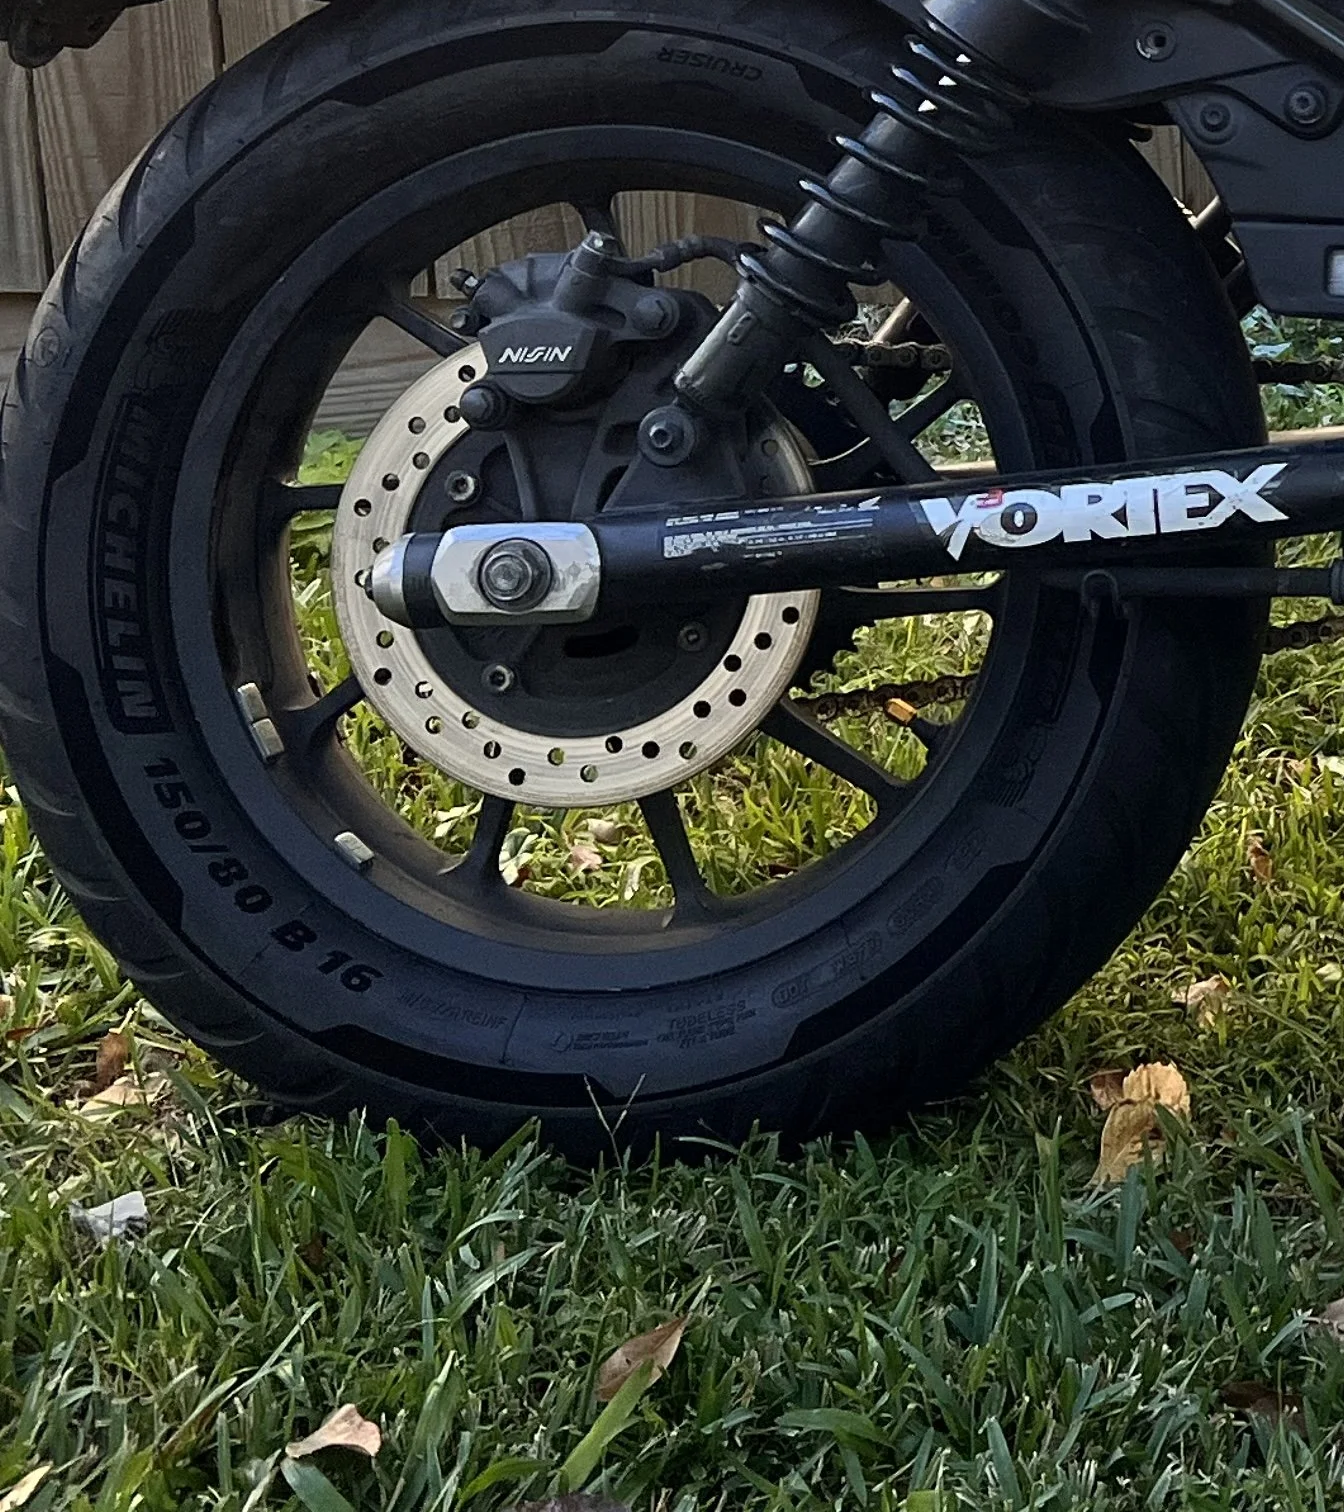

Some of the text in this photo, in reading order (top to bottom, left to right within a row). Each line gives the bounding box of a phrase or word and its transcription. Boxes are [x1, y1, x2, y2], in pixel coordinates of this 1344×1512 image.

[657, 46, 763, 80] CRUISER
[103, 399, 158, 718] MICHELIN
[920, 462, 1290, 562] VORTEX
[143, 757, 385, 993] 150/80 B 16
